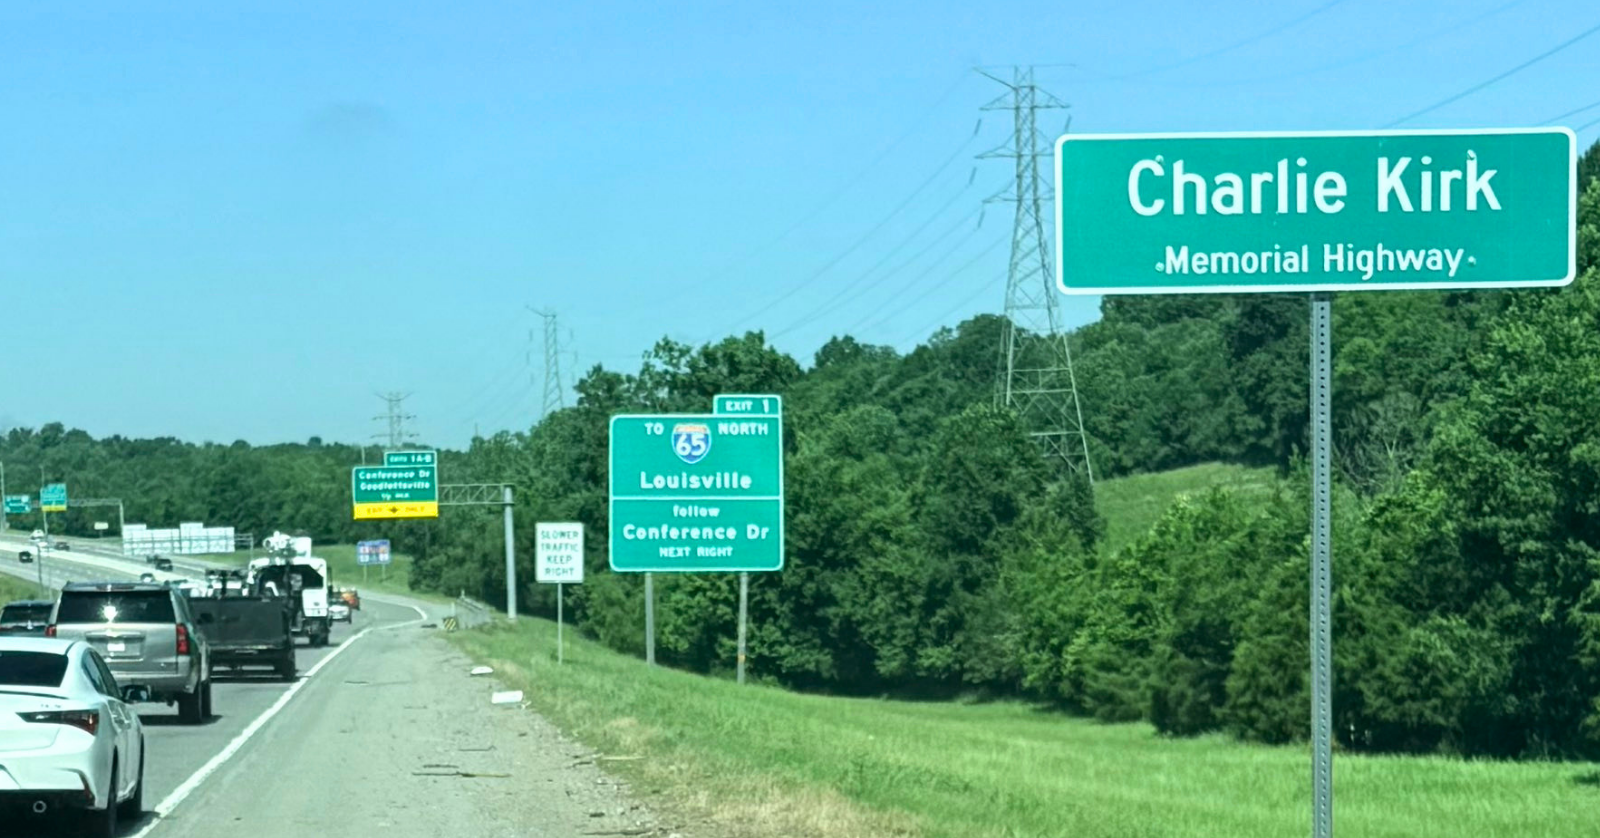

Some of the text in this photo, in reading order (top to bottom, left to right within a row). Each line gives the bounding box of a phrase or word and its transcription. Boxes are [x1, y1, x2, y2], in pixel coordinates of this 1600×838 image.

[1128, 152, 1501, 216] Charlie Kirk
[1165, 242, 1464, 280] Memorial Highway
[725, 399, 769, 413] EXIT 1
[645, 422, 664, 435] TO
[676, 434, 706, 456] 65
[718, 422, 768, 435] NORTH
[640, 471, 752, 489] Louisville
[673, 504, 720, 517] follow
[541, 530, 579, 539] SLOWER
[623, 524, 769, 540] Conference Dr
[541, 543, 578, 551] TRAFFIC
[659, 546, 733, 557] NEXT RIGHT
[547, 555, 572, 564] KEEP
[545, 567, 574, 576] RIGHT
